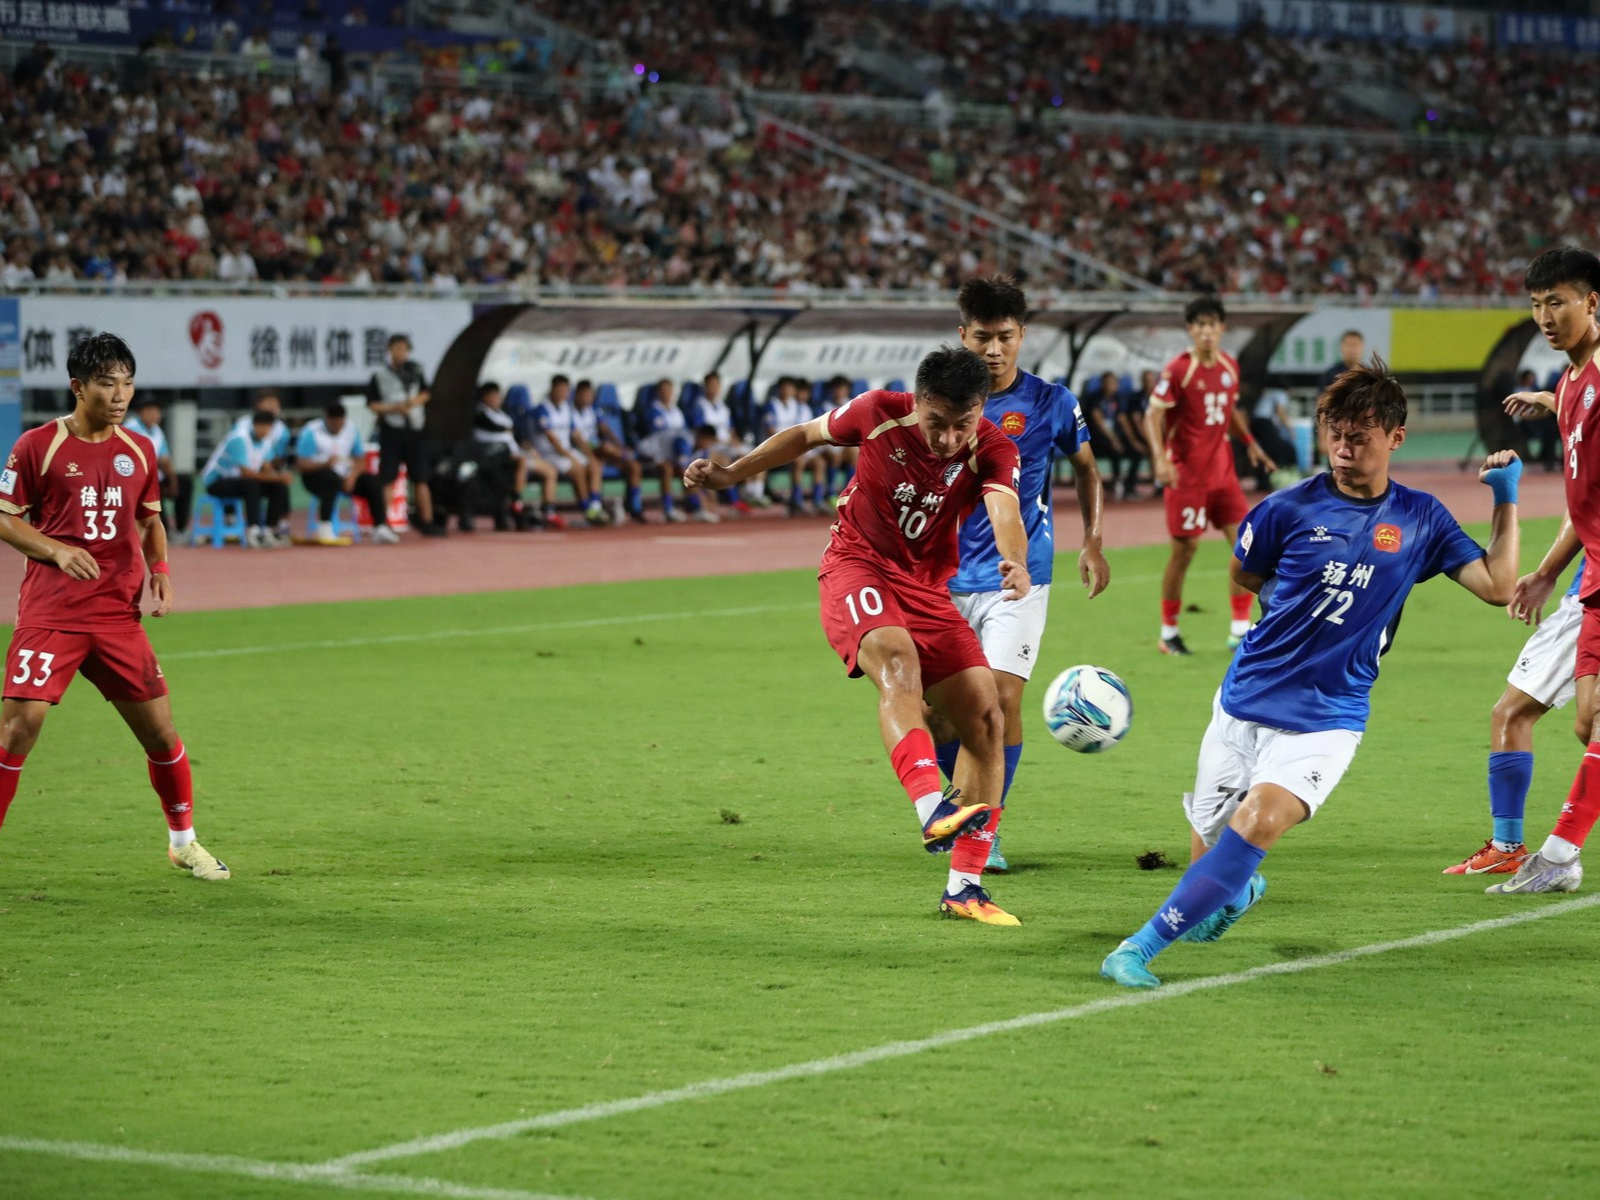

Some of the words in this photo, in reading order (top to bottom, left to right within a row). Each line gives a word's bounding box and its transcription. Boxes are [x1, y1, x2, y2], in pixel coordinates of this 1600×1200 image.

[1569, 448, 1578, 479] 9
[80, 485, 122, 507] 徐州
[893, 481, 944, 514] 徐州
[83, 509, 117, 541] 33
[898, 505, 928, 540] 10
[1181, 506, 1207, 530] 24
[1321, 560, 1375, 589] 扬州
[845, 586, 884, 625] 10
[1310, 587, 1354, 626] 72
[12, 649, 55, 687] 33
[1212, 785, 1249, 818] 7
